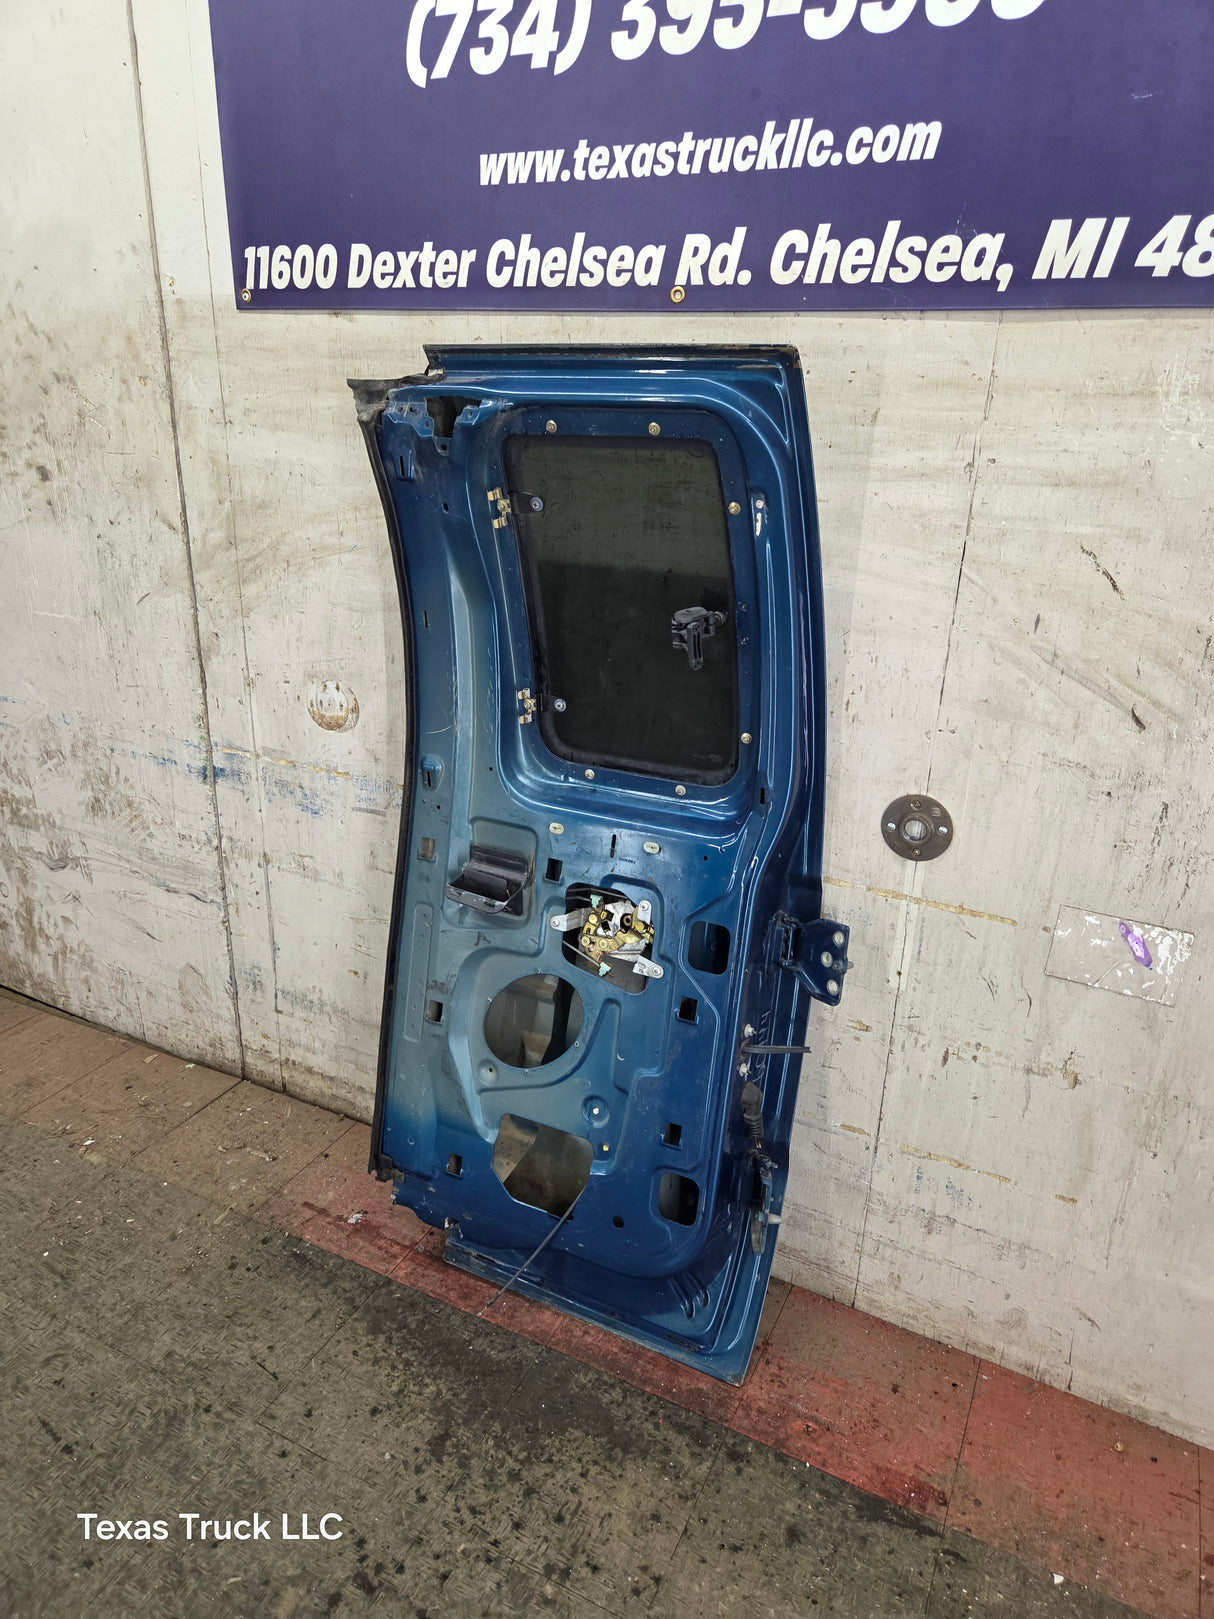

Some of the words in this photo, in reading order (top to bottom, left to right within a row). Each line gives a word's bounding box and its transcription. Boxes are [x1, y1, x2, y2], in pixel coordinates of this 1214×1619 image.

[405, 0, 593, 89] (734)
[479, 117, 943, 187] www.texastruckllc.com
[243, 243, 338, 290] 11600
[347, 241, 477, 289] Dexter
[486, 231, 667, 288] Chelsea
[674, 233, 752, 286] Rd.
[769, 219, 1014, 292] Chelsea,
[1031, 216, 1131, 280] MI
